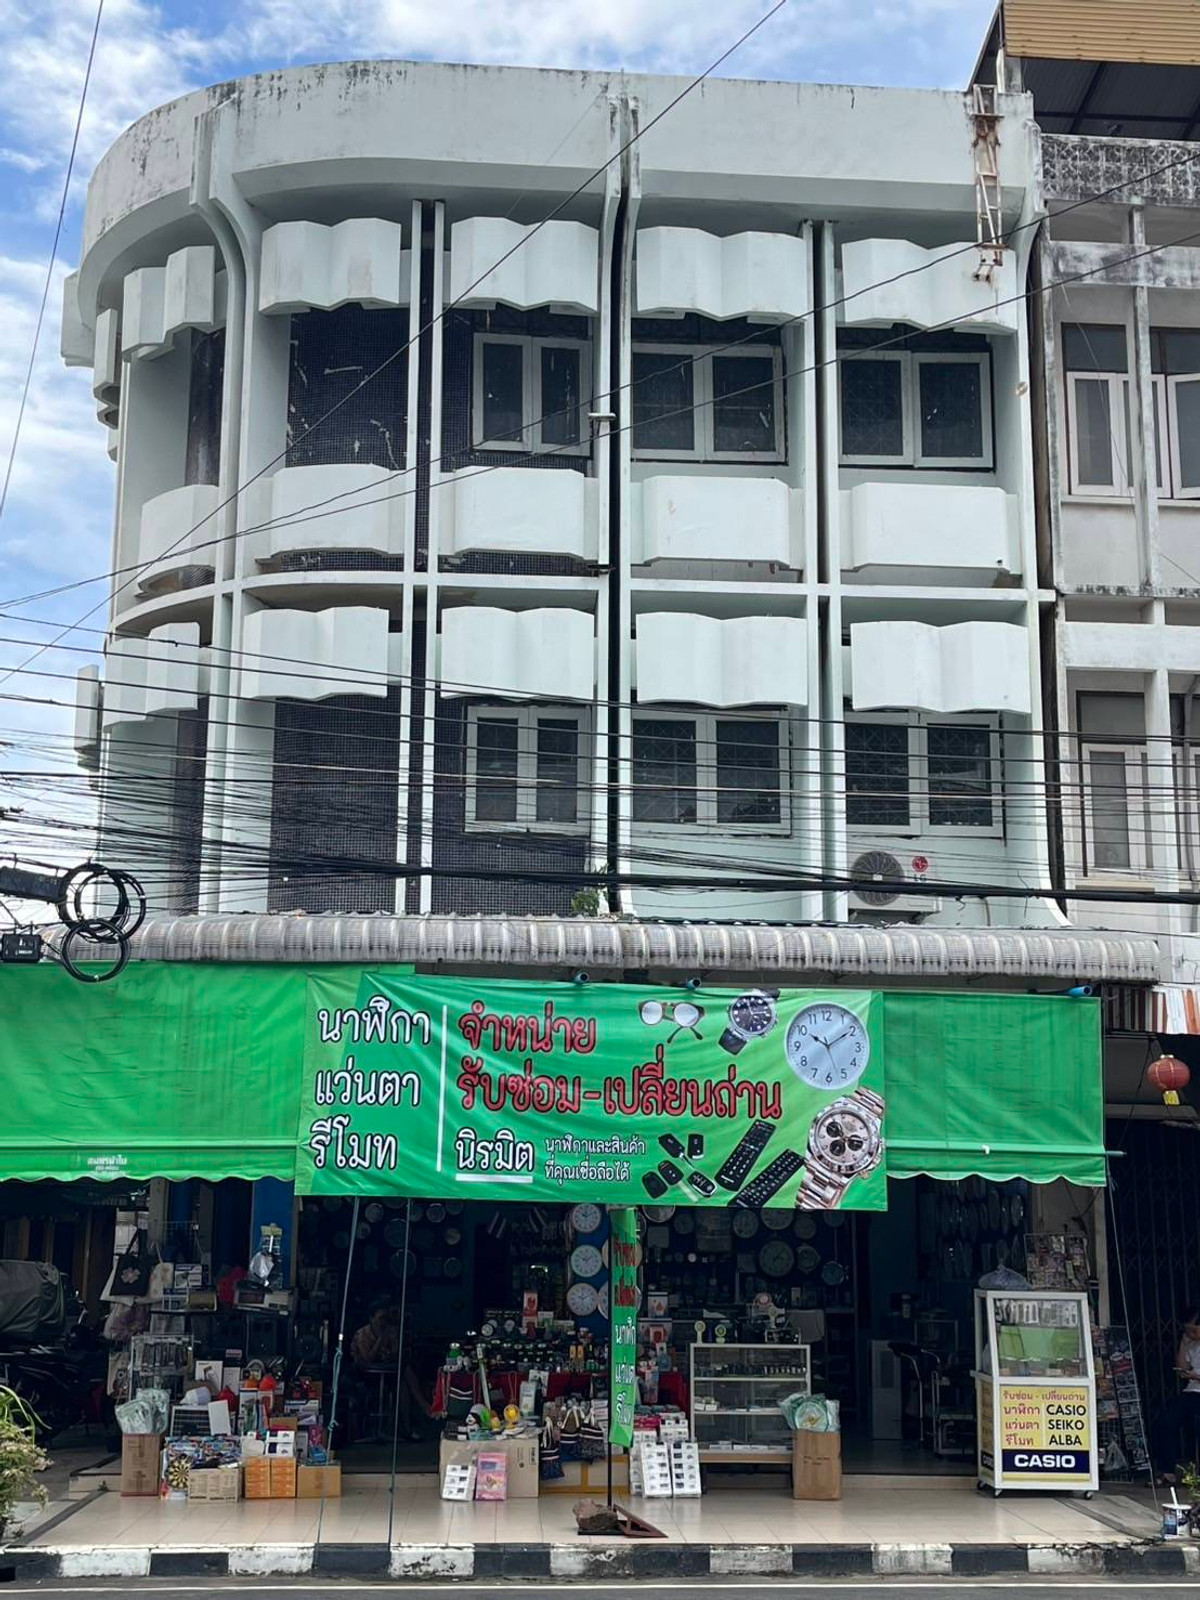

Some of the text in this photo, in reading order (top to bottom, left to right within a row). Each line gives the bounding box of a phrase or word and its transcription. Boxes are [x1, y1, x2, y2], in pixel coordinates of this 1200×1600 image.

[318, 995, 431, 1044] นาฬิกา
[808, 1013, 817, 1025] 11
[821, 1010, 832, 1022] 12
[459, 1000, 596, 1053] จำหน่าย
[798, 1025, 808, 1036] 10
[849, 1025, 856, 1036] 2
[794, 1041, 801, 1052] 9
[855, 1042, 862, 1053] 3
[801, 1056, 808, 1067] 8
[850, 1057, 857, 1067] 4
[811, 1068, 818, 1078] 7
[825, 1072, 833, 1083] 6
[840, 1068, 847, 1079] 5
[316, 1056, 421, 1106] แว่นตา
[310, 1115, 397, 1169] รีโมท
[545, 1133, 645, 1154] นาฬิกาและสินค้า
[455, 1127, 534, 1171] นิรมิต
[544, 1154, 630, 1185] ที่คุณเชื่อถือได้
[1004, 1403, 1040, 1415] นาฬิกา
[1046, 1404, 1086, 1415] CASIO
[1005, 1418, 1039, 1430] แว่นตา
[1048, 1419, 1084, 1430] SEIKO
[1006, 1433, 1034, 1446] รีโมท
[1049, 1434, 1082, 1445] ALBA
[1014, 1454, 1076, 1468] CASIO
